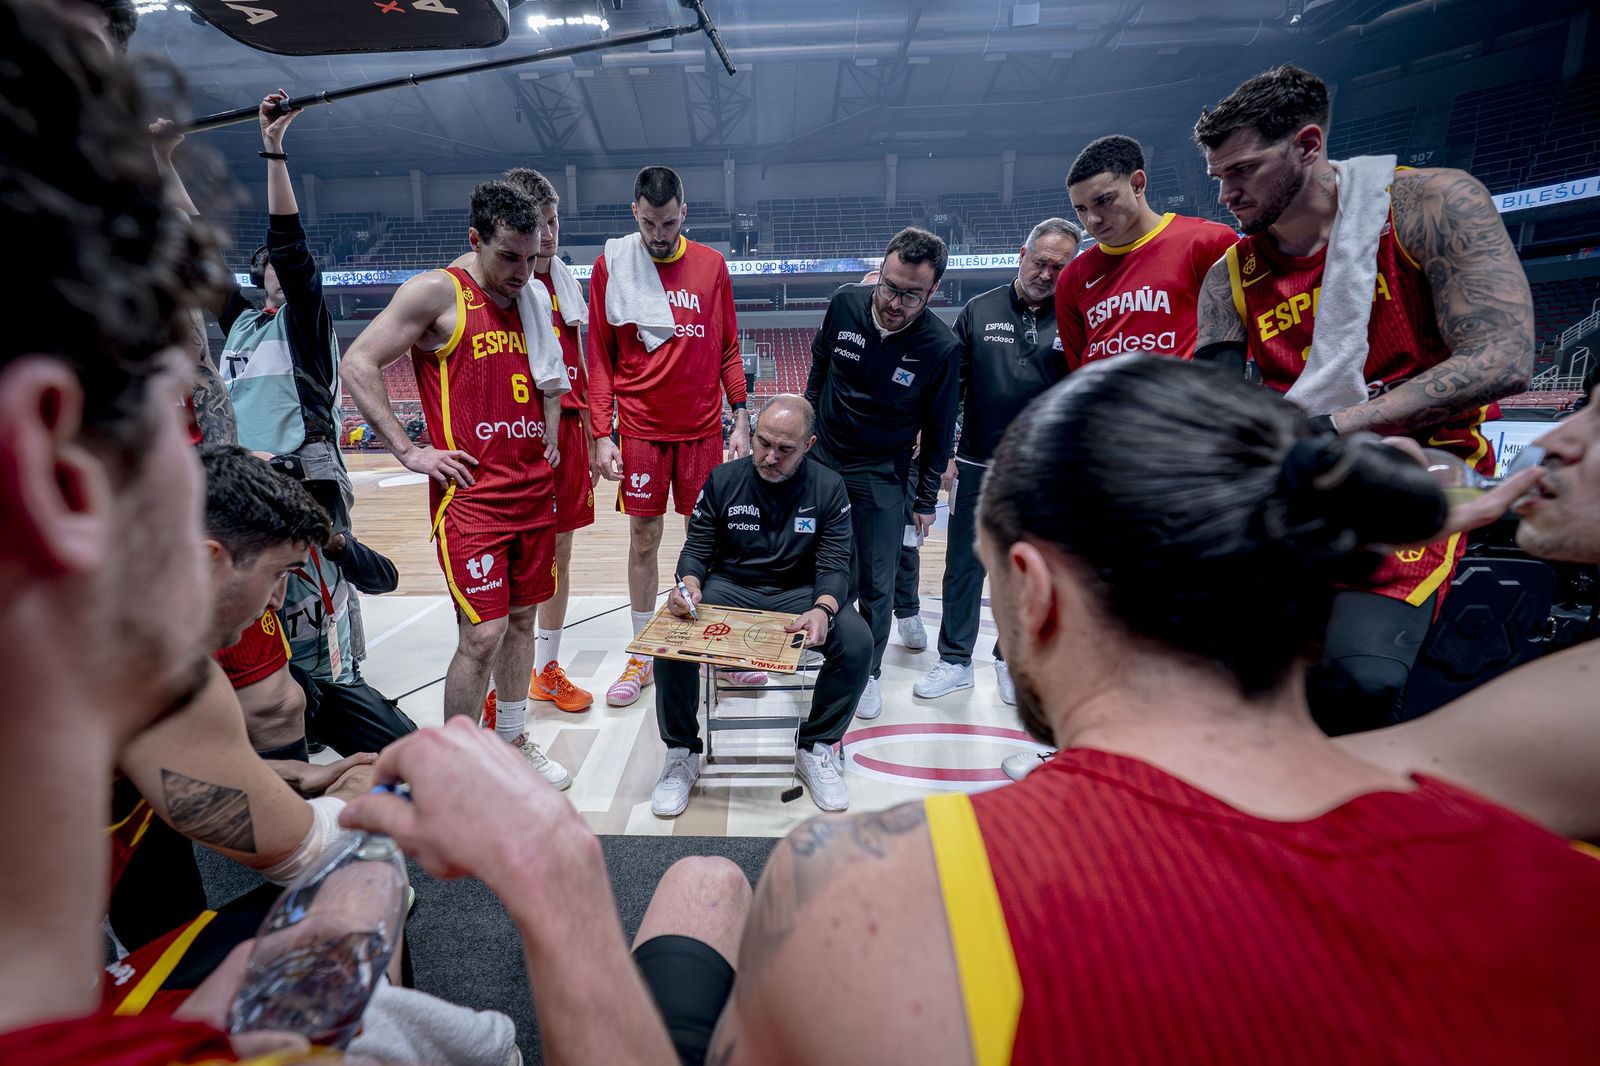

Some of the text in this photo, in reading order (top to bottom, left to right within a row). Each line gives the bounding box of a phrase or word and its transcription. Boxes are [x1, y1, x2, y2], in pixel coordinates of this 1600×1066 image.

[1410, 151, 1434, 163] 307
[1167, 195, 1185, 204] 306
[1501, 183, 1588, 209] BIĻEŠU
[740, 219, 754, 228] 304
[934, 214, 948, 222] 305
[948, 256, 988, 269] BIĻEŠU
[667, 288, 701, 313] AÑA
[1086, 285, 1171, 330] ESPAÑA
[984, 322, 1015, 333] ESPAÑA
[471, 330, 528, 360] ESPA
[837, 331, 866, 349] ESPAÑA
[983, 335, 1015, 345] endesa
[1087, 331, 1176, 358] endesa
[834, 346, 861, 362] endesa
[511, 373, 530, 404] 6
[475, 415, 545, 441] endes
[727, 504, 761, 518] ESPAÑA
[727, 521, 760, 531] endesa
[287, 600, 322, 639] TV
